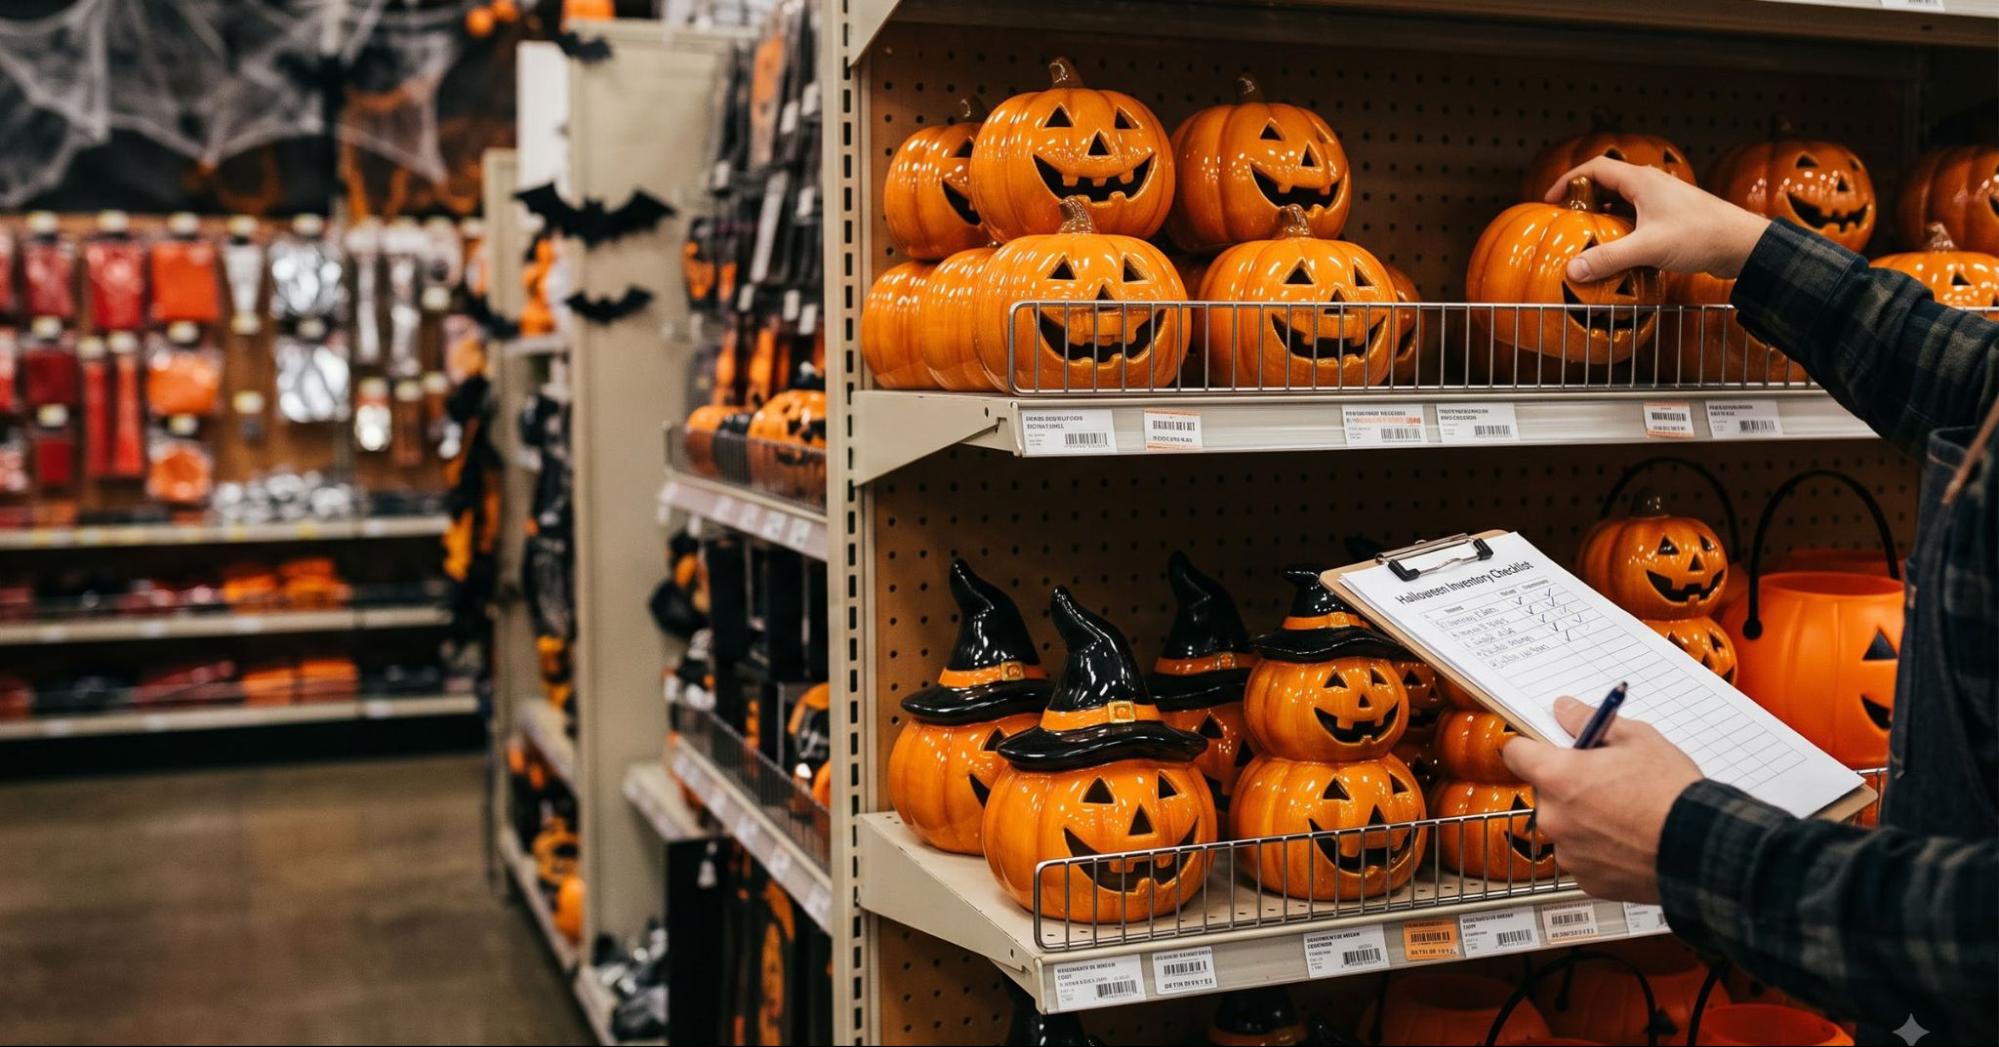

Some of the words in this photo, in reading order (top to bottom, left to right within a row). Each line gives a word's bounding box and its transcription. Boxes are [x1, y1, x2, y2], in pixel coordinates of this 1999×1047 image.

[1395, 586, 1450, 605] Halloween
[1446, 573, 1495, 591] Inventory
[1489, 560, 1534, 579] Checklist
